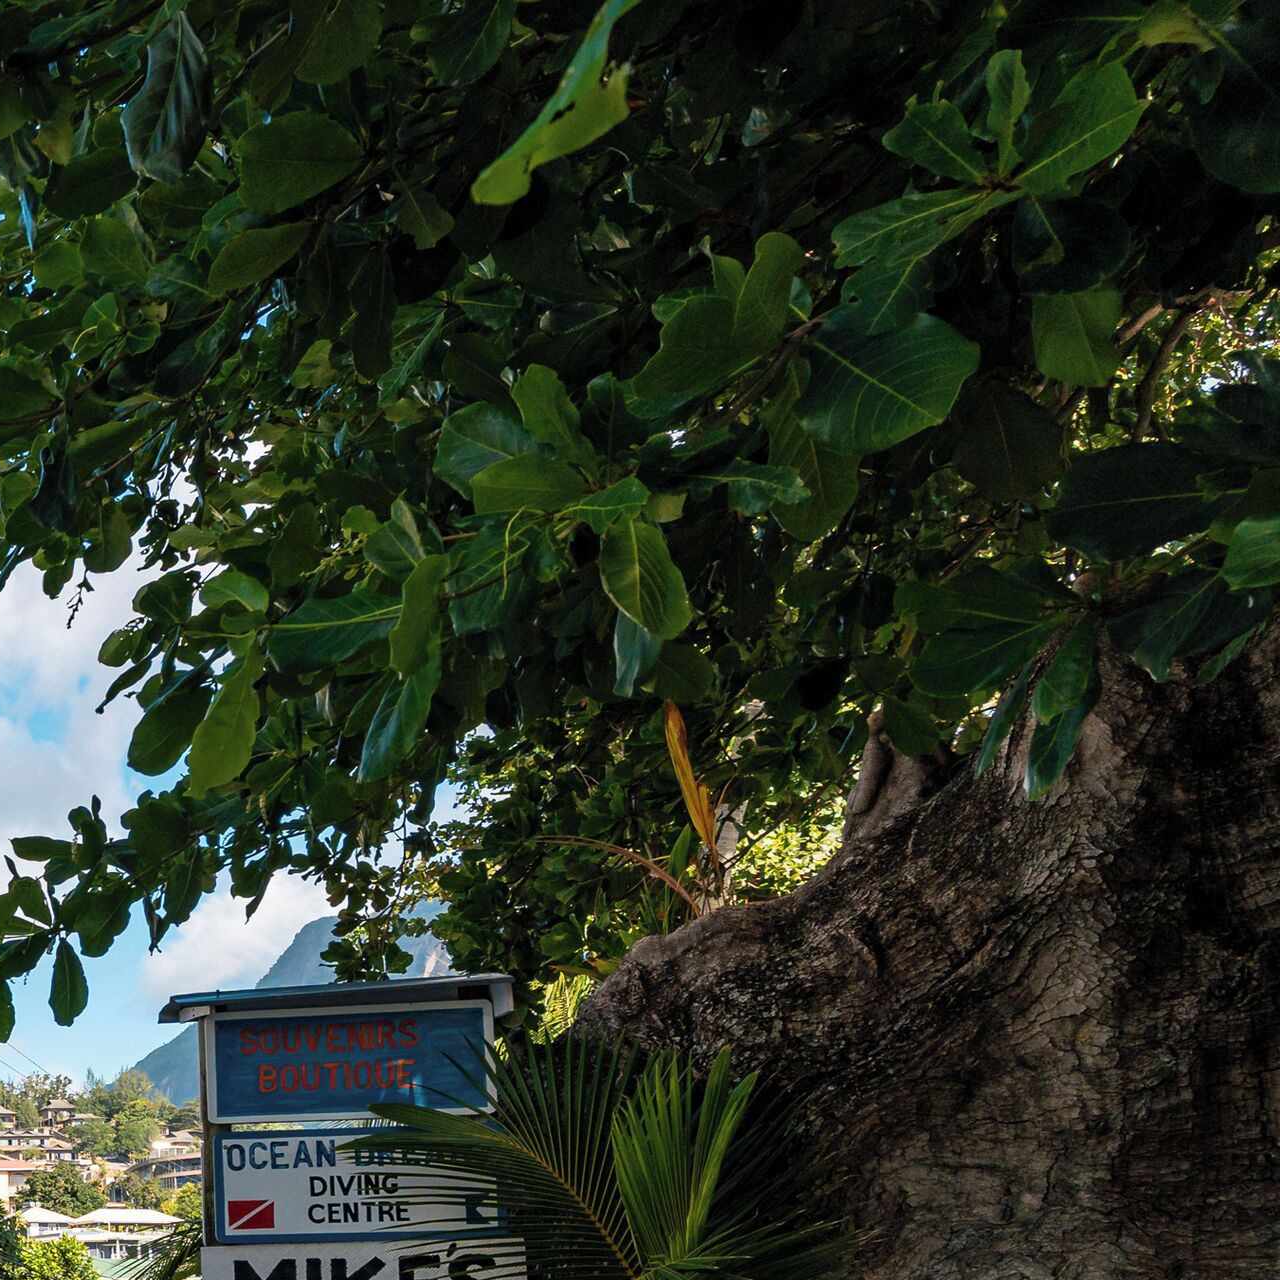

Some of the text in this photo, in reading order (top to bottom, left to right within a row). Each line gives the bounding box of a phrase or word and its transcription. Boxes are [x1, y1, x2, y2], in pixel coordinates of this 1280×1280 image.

[240, 1019, 419, 1055] SOUVENIRS
[258, 1059, 417, 1094] BOUTIQUE
[226, 1140, 336, 1172] OCEAN
[309, 1174, 399, 1197] DIVING
[307, 1201, 410, 1224] CENTRE
